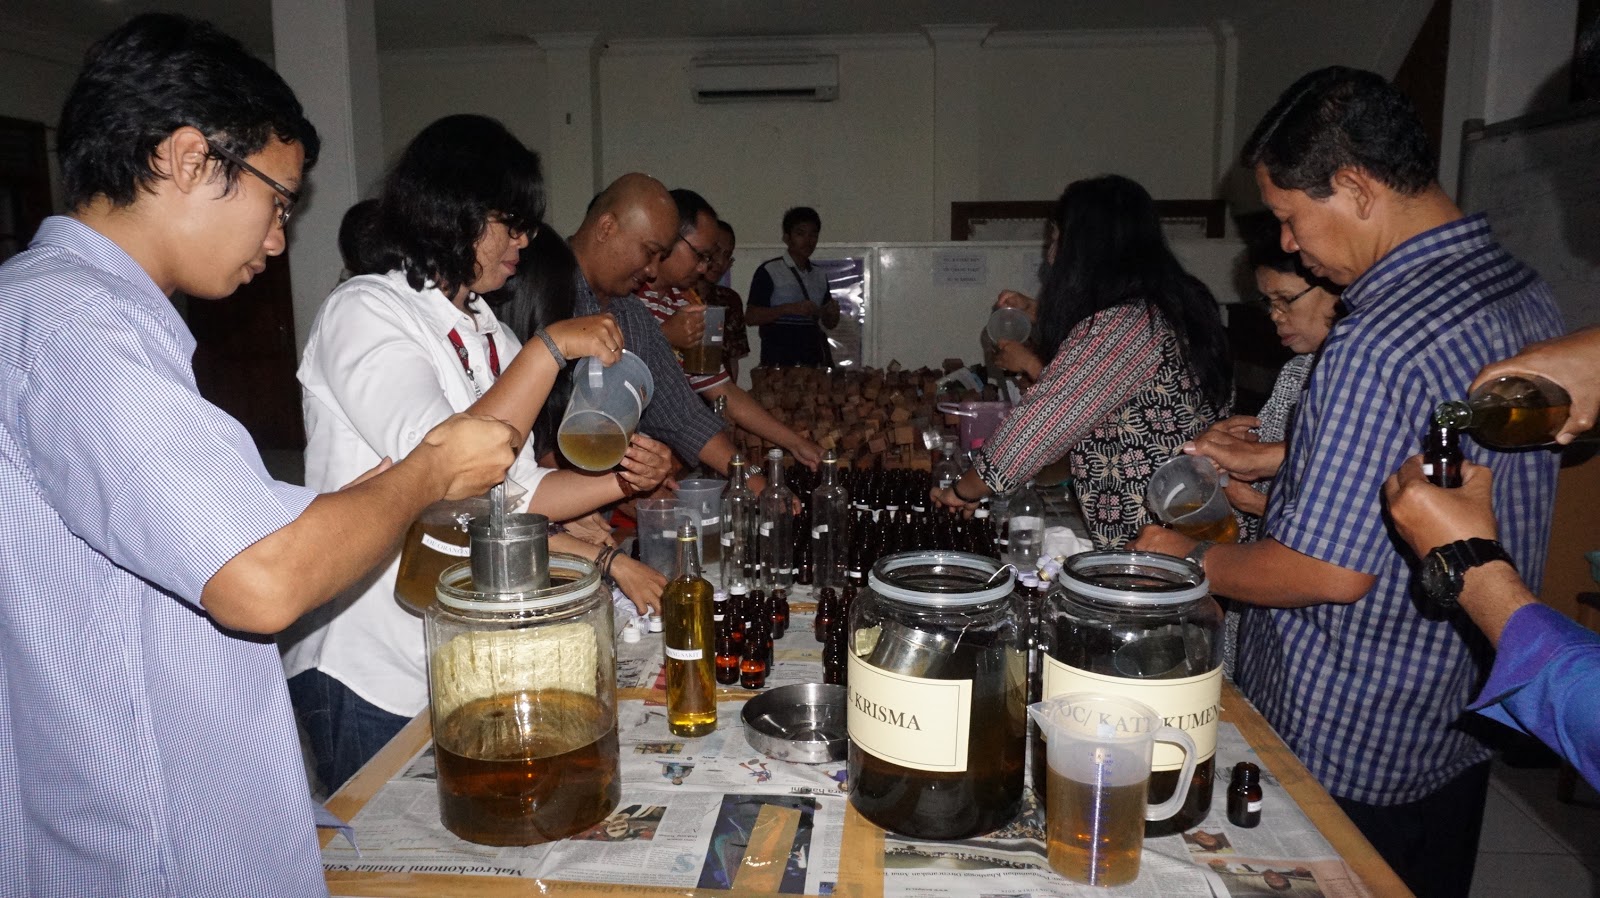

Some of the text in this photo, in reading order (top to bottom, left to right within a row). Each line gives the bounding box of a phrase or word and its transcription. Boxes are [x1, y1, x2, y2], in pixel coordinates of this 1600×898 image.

[855, 691, 922, 732] KRISMA
[355, 865, 406, 873] Dinilai
[408, 865, 526, 877] Makroekonomi
